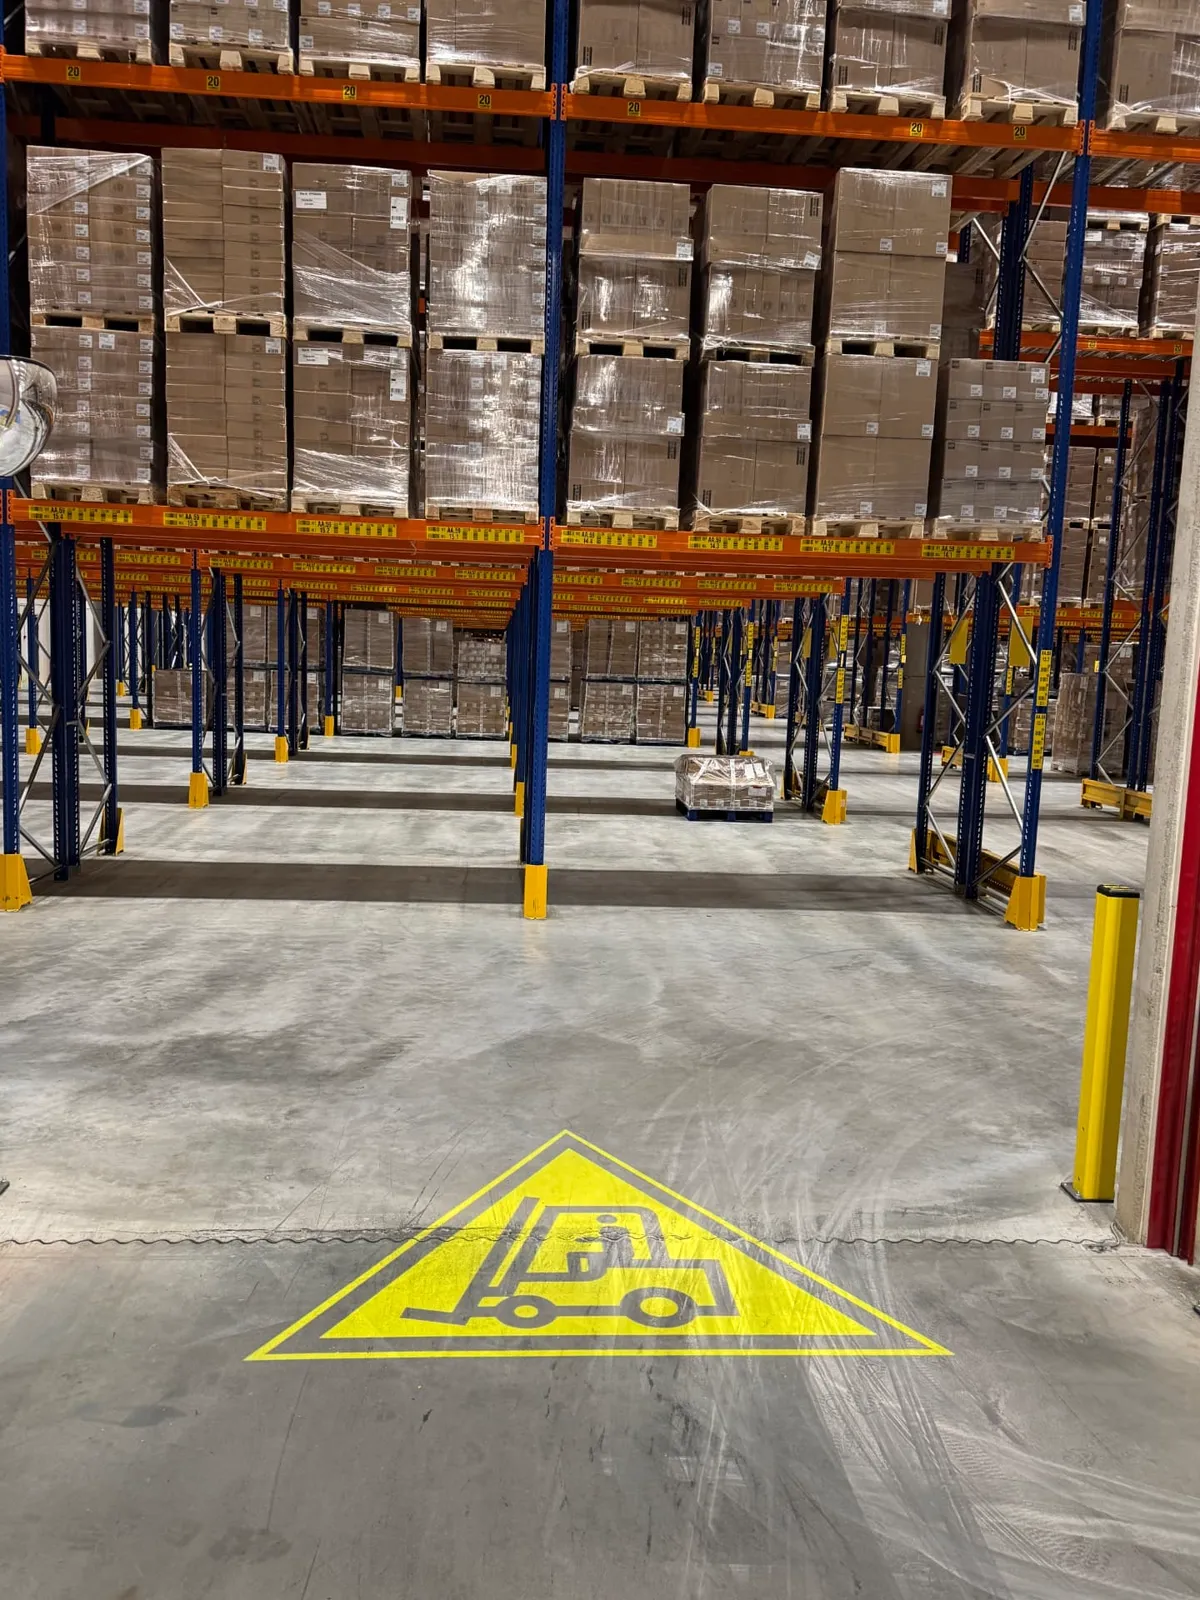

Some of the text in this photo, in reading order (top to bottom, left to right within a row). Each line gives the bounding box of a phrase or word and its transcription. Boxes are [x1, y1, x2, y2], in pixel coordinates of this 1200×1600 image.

[68, 66, 79, 76] 20
[208, 76, 219, 87] 20
[344, 86, 355, 96] 20
[479, 95, 490, 105] 20
[628, 102, 640, 112] 20
[911, 123, 922, 133] 20
[1014, 127, 1025, 137] 20
